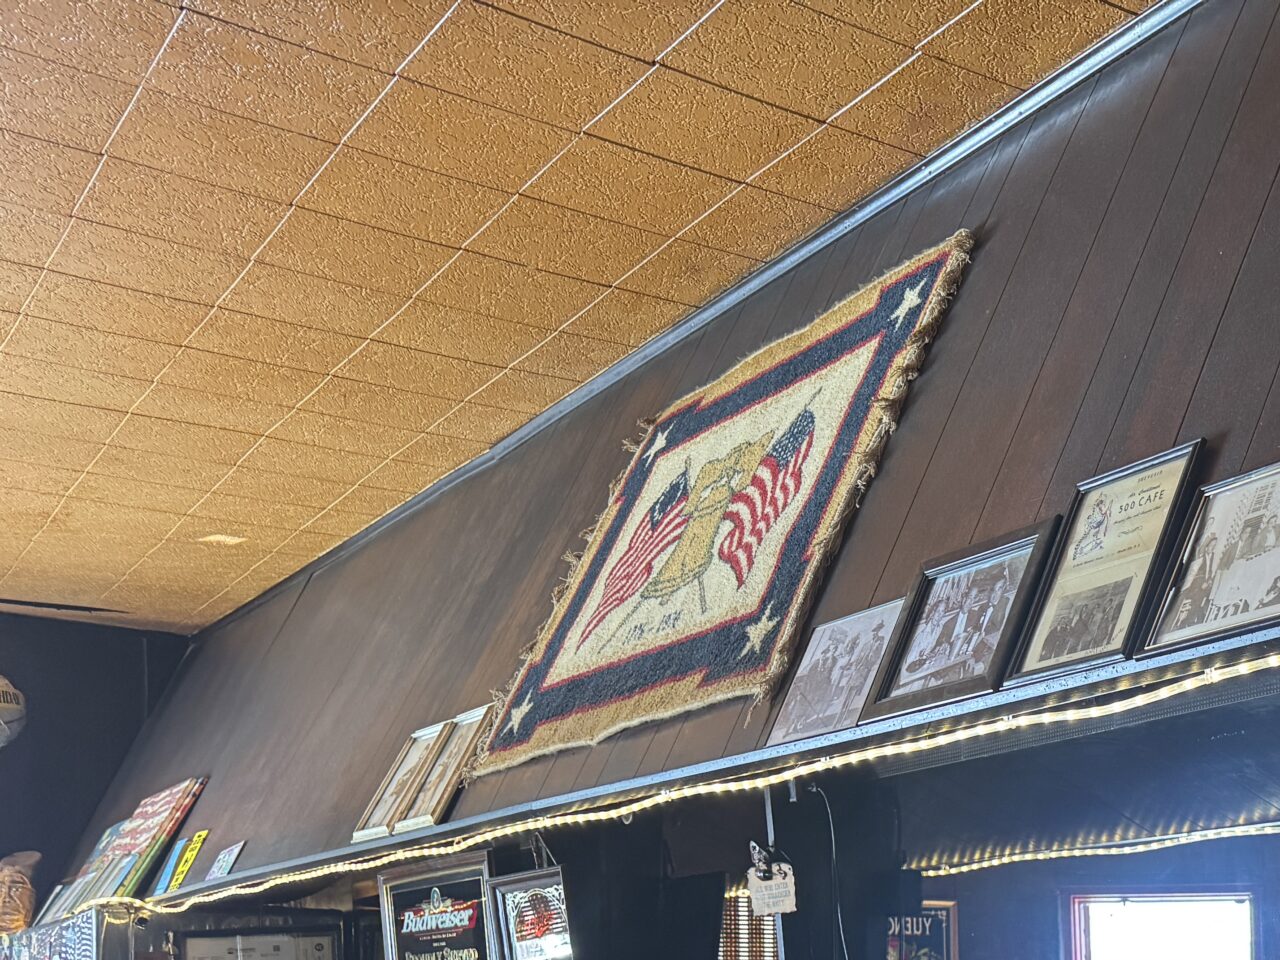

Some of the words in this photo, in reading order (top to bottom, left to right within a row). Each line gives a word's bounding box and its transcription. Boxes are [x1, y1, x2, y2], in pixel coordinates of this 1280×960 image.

[1119, 501, 1135, 514] 500
[1138, 489, 1165, 507] CAFE
[401, 908, 473, 933] Budweiser
